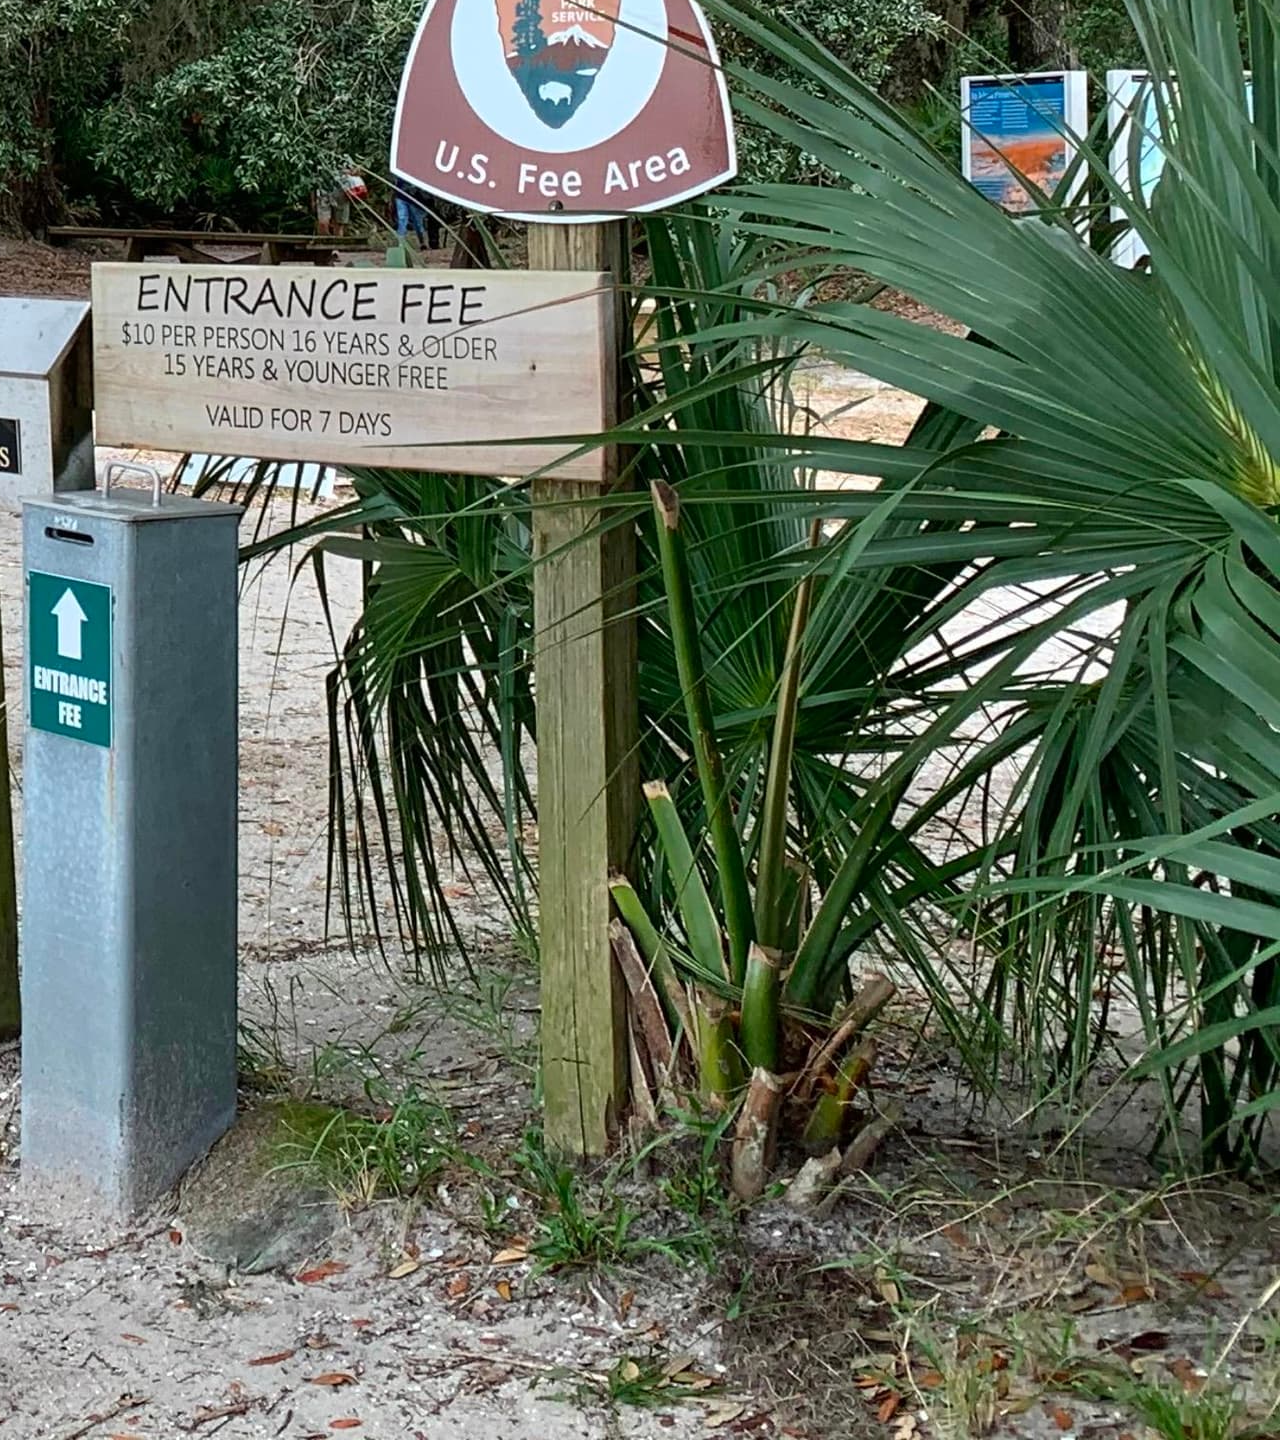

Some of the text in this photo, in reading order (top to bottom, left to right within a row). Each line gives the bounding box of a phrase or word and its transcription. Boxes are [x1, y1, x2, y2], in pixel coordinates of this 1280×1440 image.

[552, 10, 607, 23] SERVICE
[434, 140, 691, 197] U.S. Fee Area
[137, 274, 486, 326] ENTRANCE FEE
[121, 321, 498, 362] $10 PER PERSON 16 YEARS & OLDER
[164, 354, 449, 390] 15 YEARS & YOUNGER FREE
[205, 404, 392, 436] VALID FOR 7 DAYS
[34, 665, 107, 705] ENTRANCE
[58, 701, 82, 729] FEE
